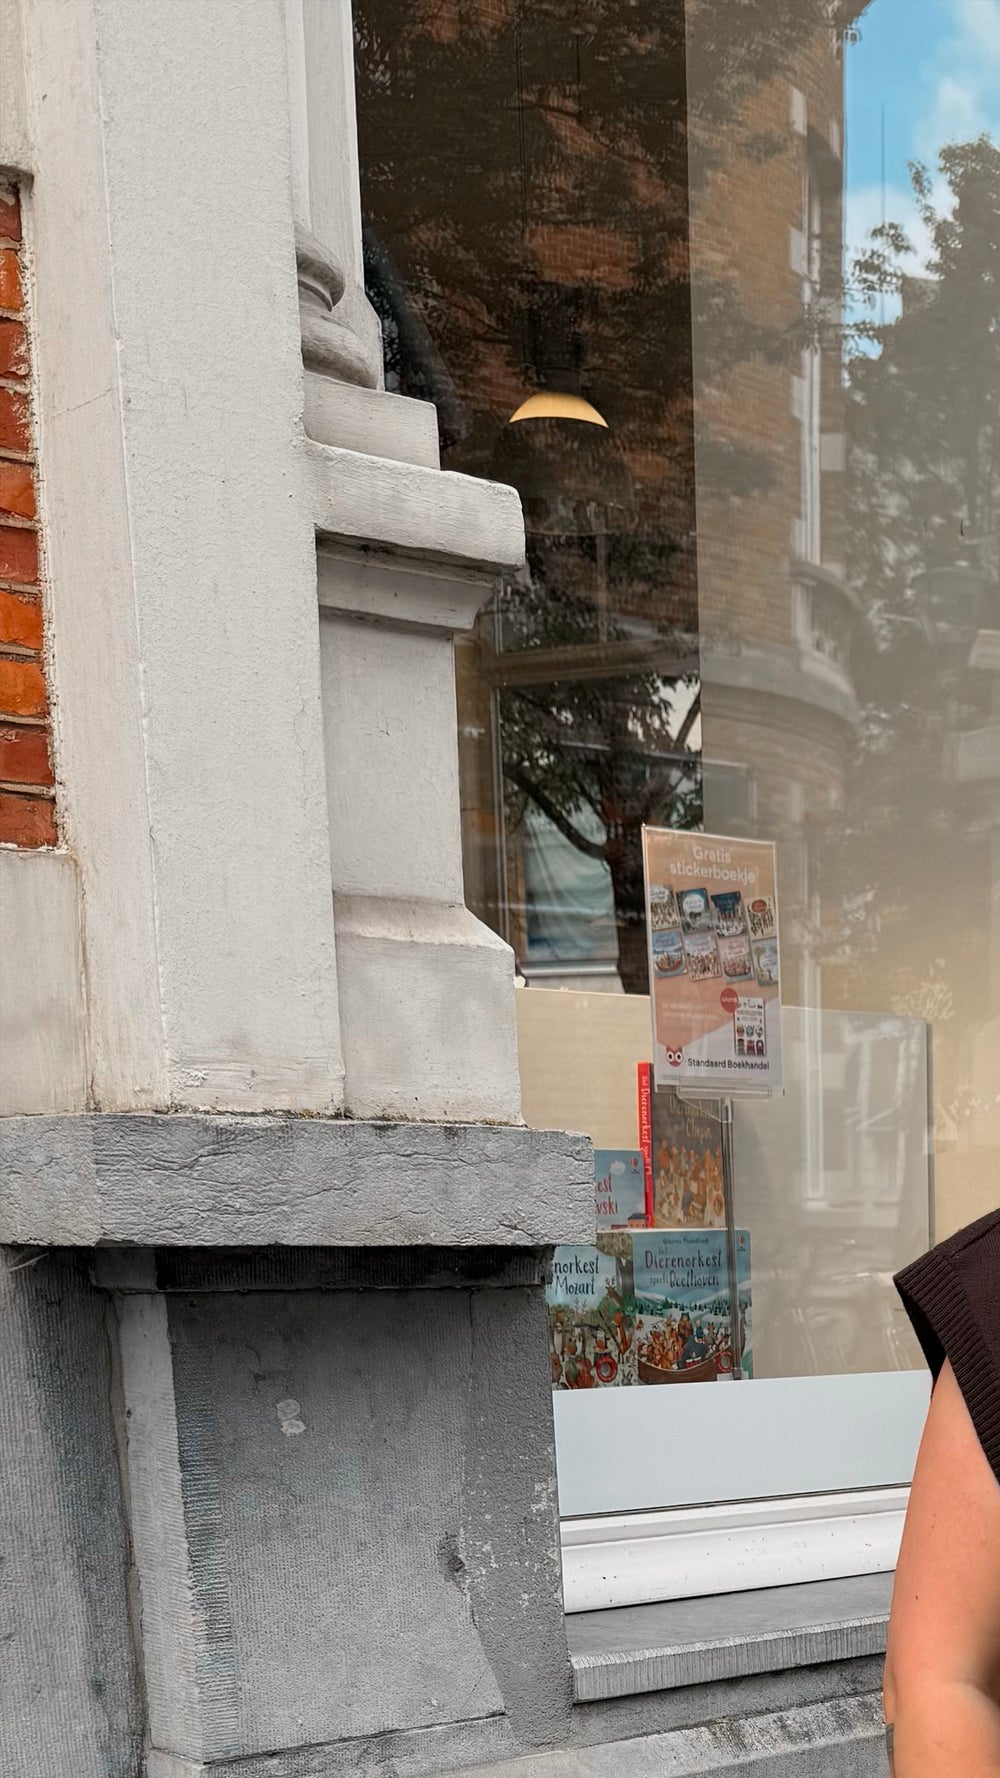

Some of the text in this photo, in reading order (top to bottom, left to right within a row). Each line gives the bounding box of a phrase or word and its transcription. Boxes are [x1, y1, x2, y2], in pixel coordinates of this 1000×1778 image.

[692, 846, 731, 863] Gratis
[670, 861, 755, 886] stickerboekje
[688, 1058, 770, 1071] Standaard Boekhandel
[645, 1249, 722, 1269] Dierenorkest
[555, 1275, 595, 1295] Mozart
[669, 1269, 720, 1288] Beethoven
